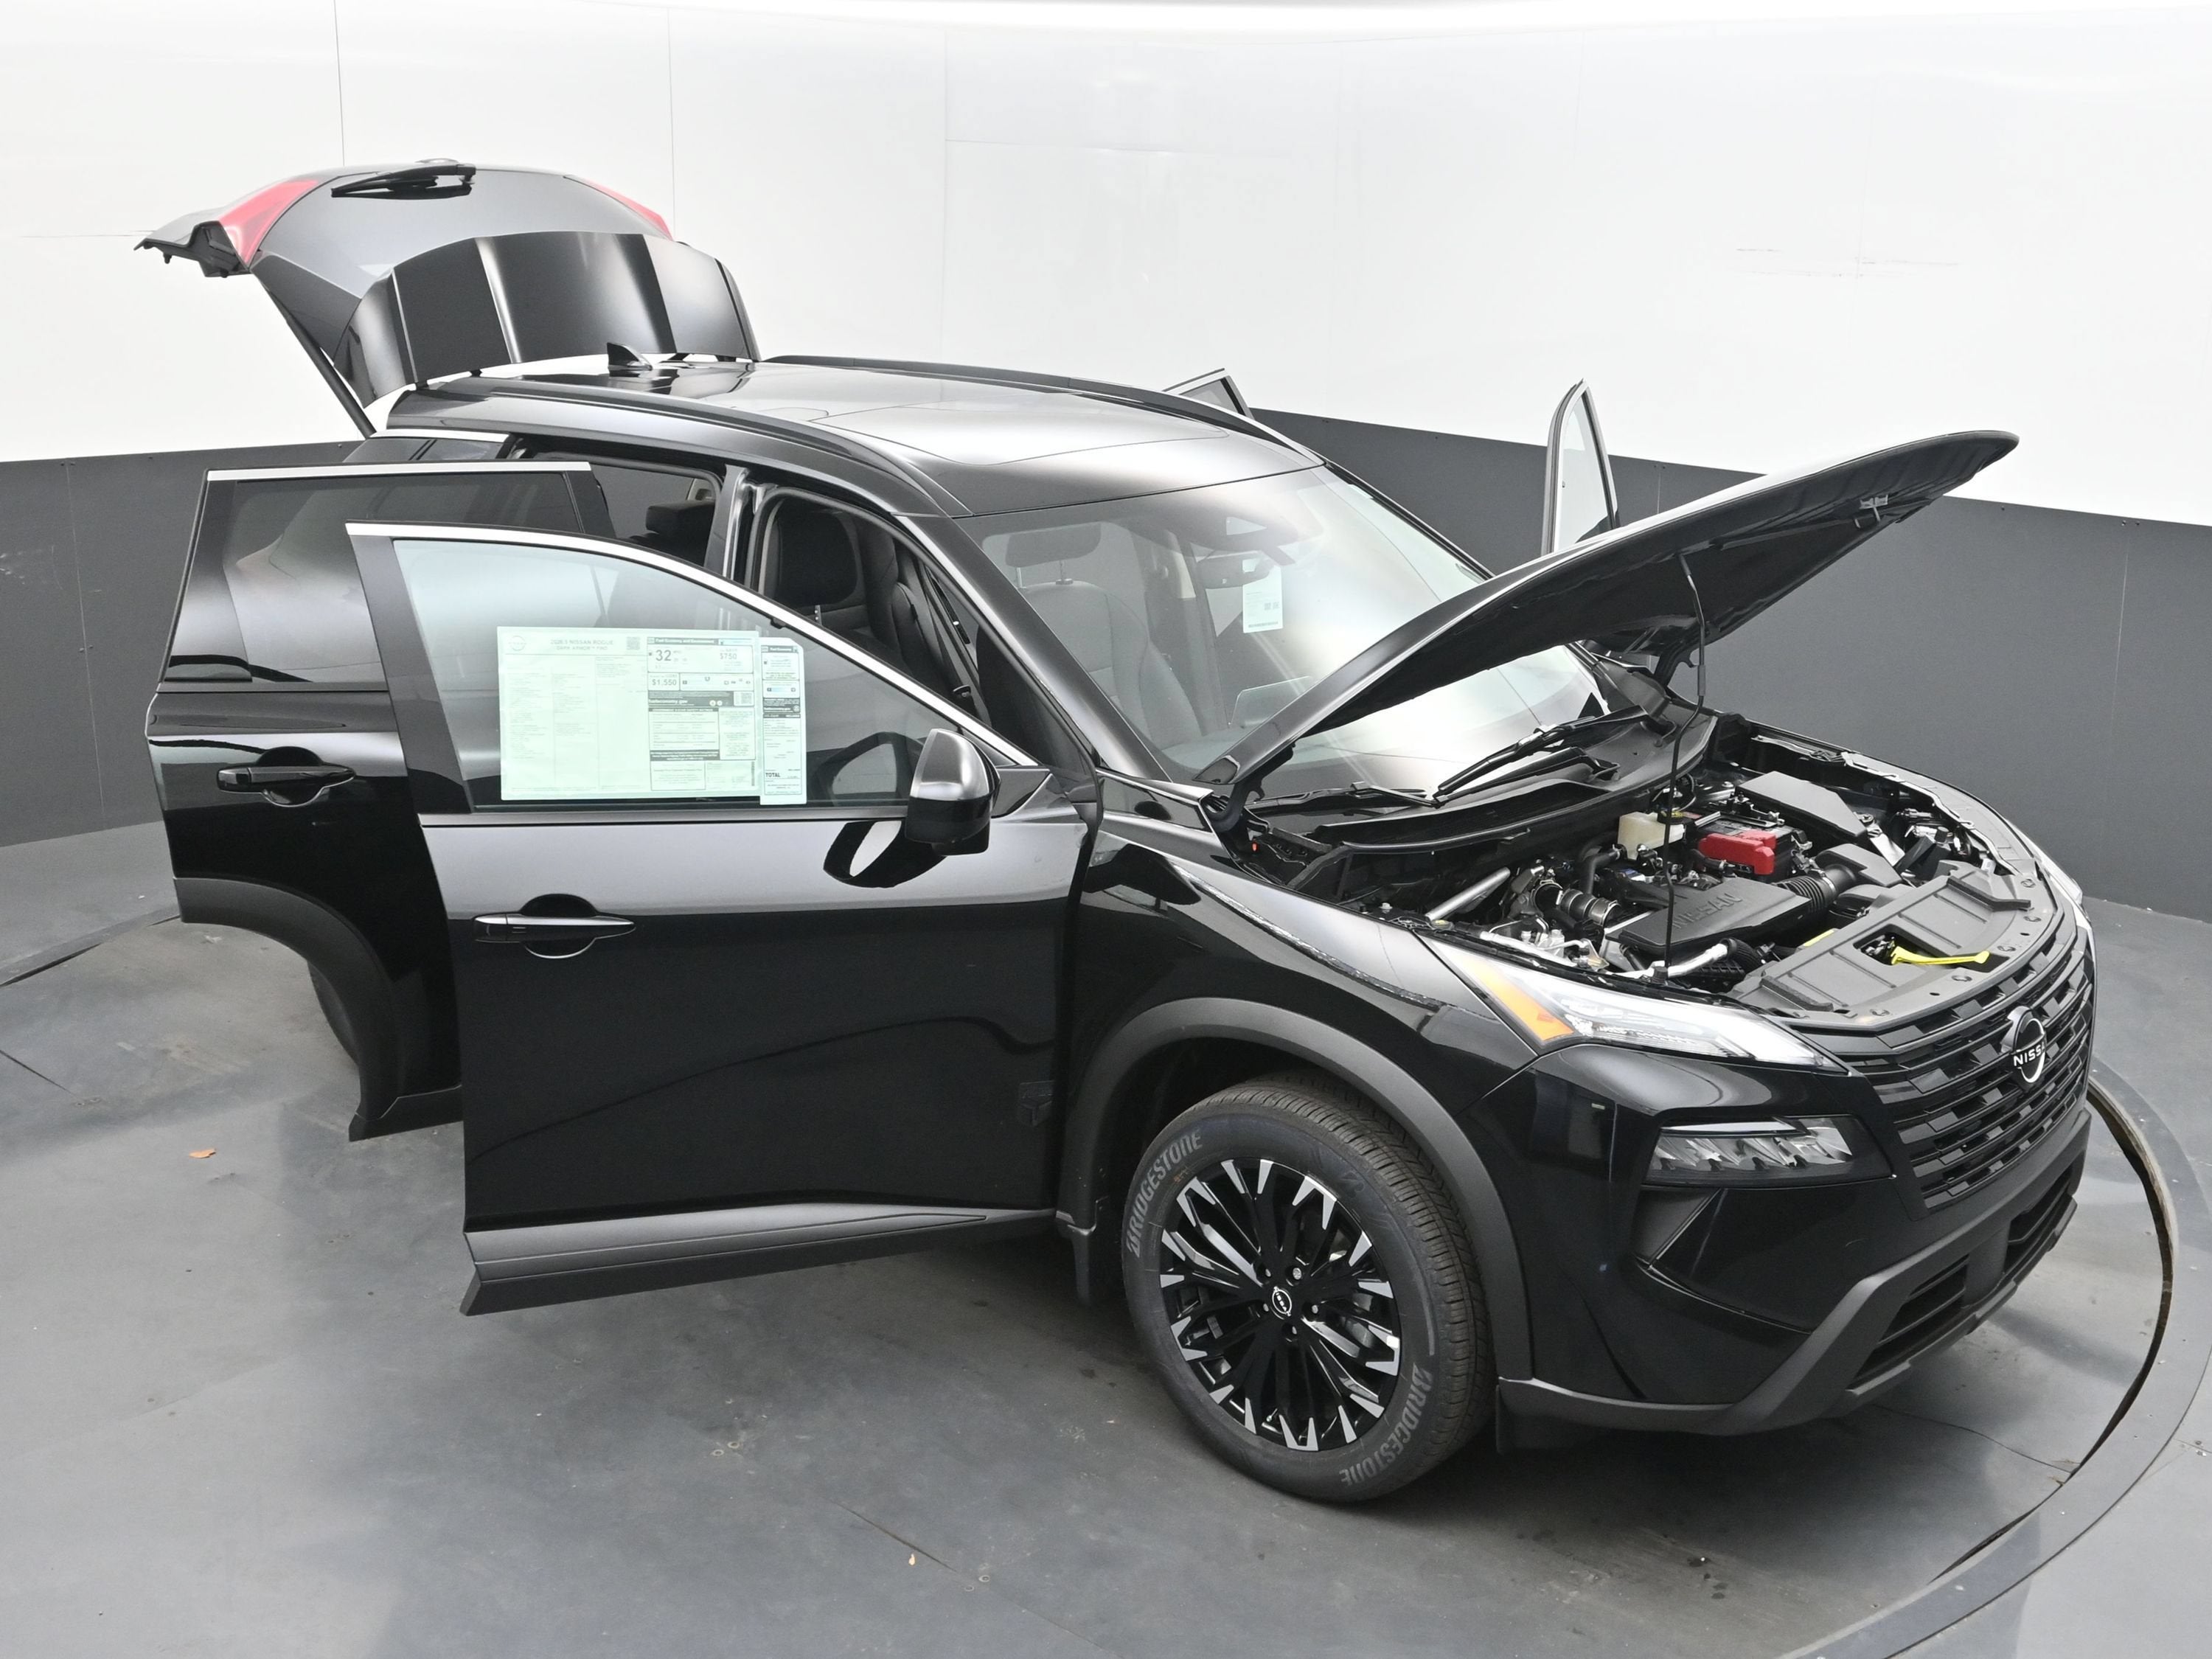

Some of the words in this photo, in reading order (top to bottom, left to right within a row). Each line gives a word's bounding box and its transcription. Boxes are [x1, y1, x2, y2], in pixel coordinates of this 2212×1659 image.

[655, 650, 672, 661] 32
[1126, 1129, 1203, 1258] BRIDGESTONE
[1339, 1363, 1433, 1486] BRIDGESTONE
